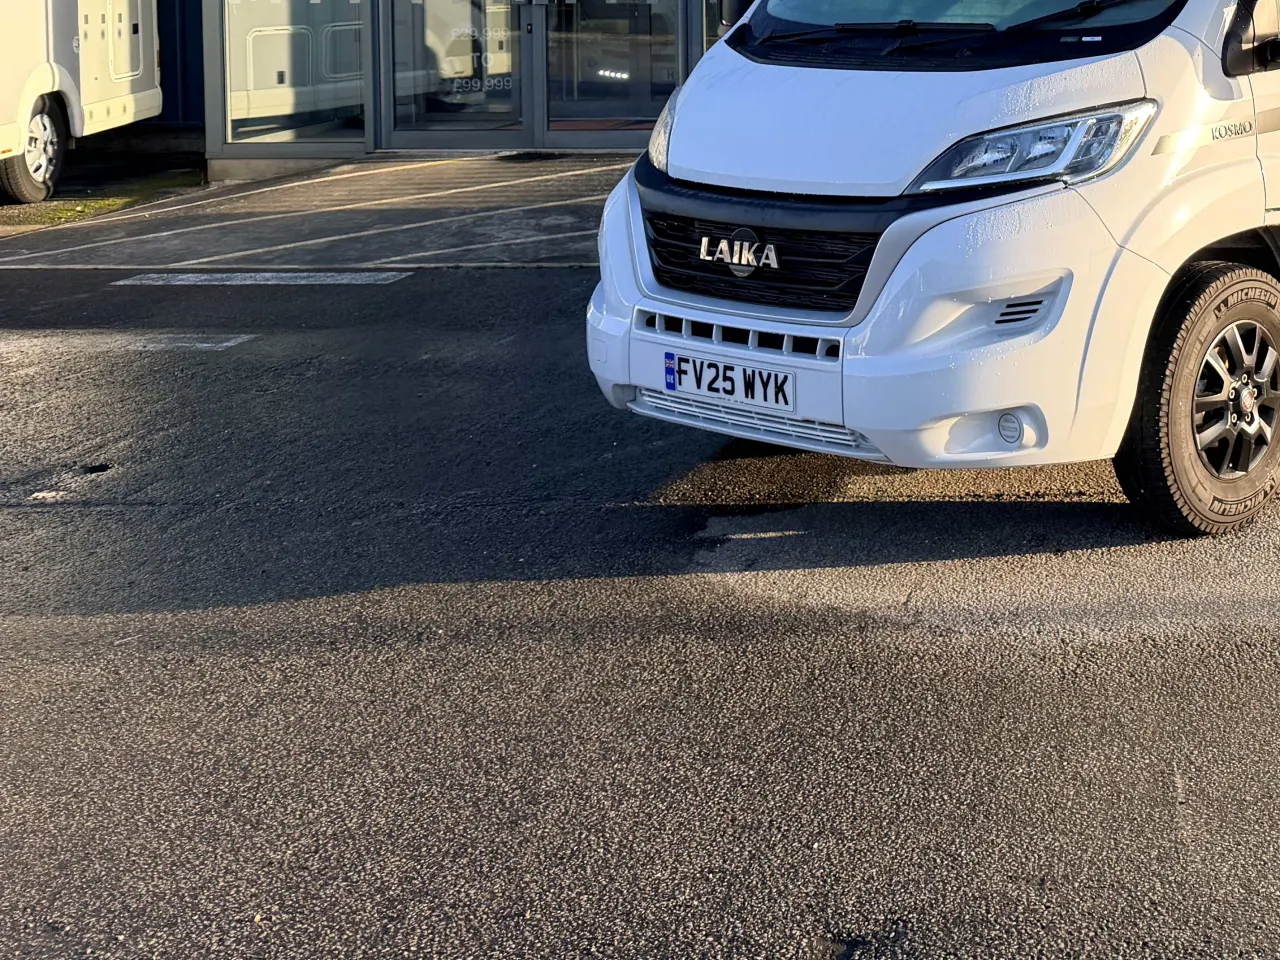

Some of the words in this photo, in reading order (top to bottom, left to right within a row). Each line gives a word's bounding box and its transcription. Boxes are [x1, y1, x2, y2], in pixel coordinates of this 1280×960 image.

[471, 51, 494, 68] TO
[453, 77, 513, 93] £99,999
[1211, 120, 1253, 141] KOSMO
[700, 236, 780, 269] LAIKA
[1227, 287, 1278, 308] MICHELIN
[676, 356, 736, 396] FV25
[742, 367, 790, 406] WYK
[1209, 488, 1265, 516] MICHELIN
